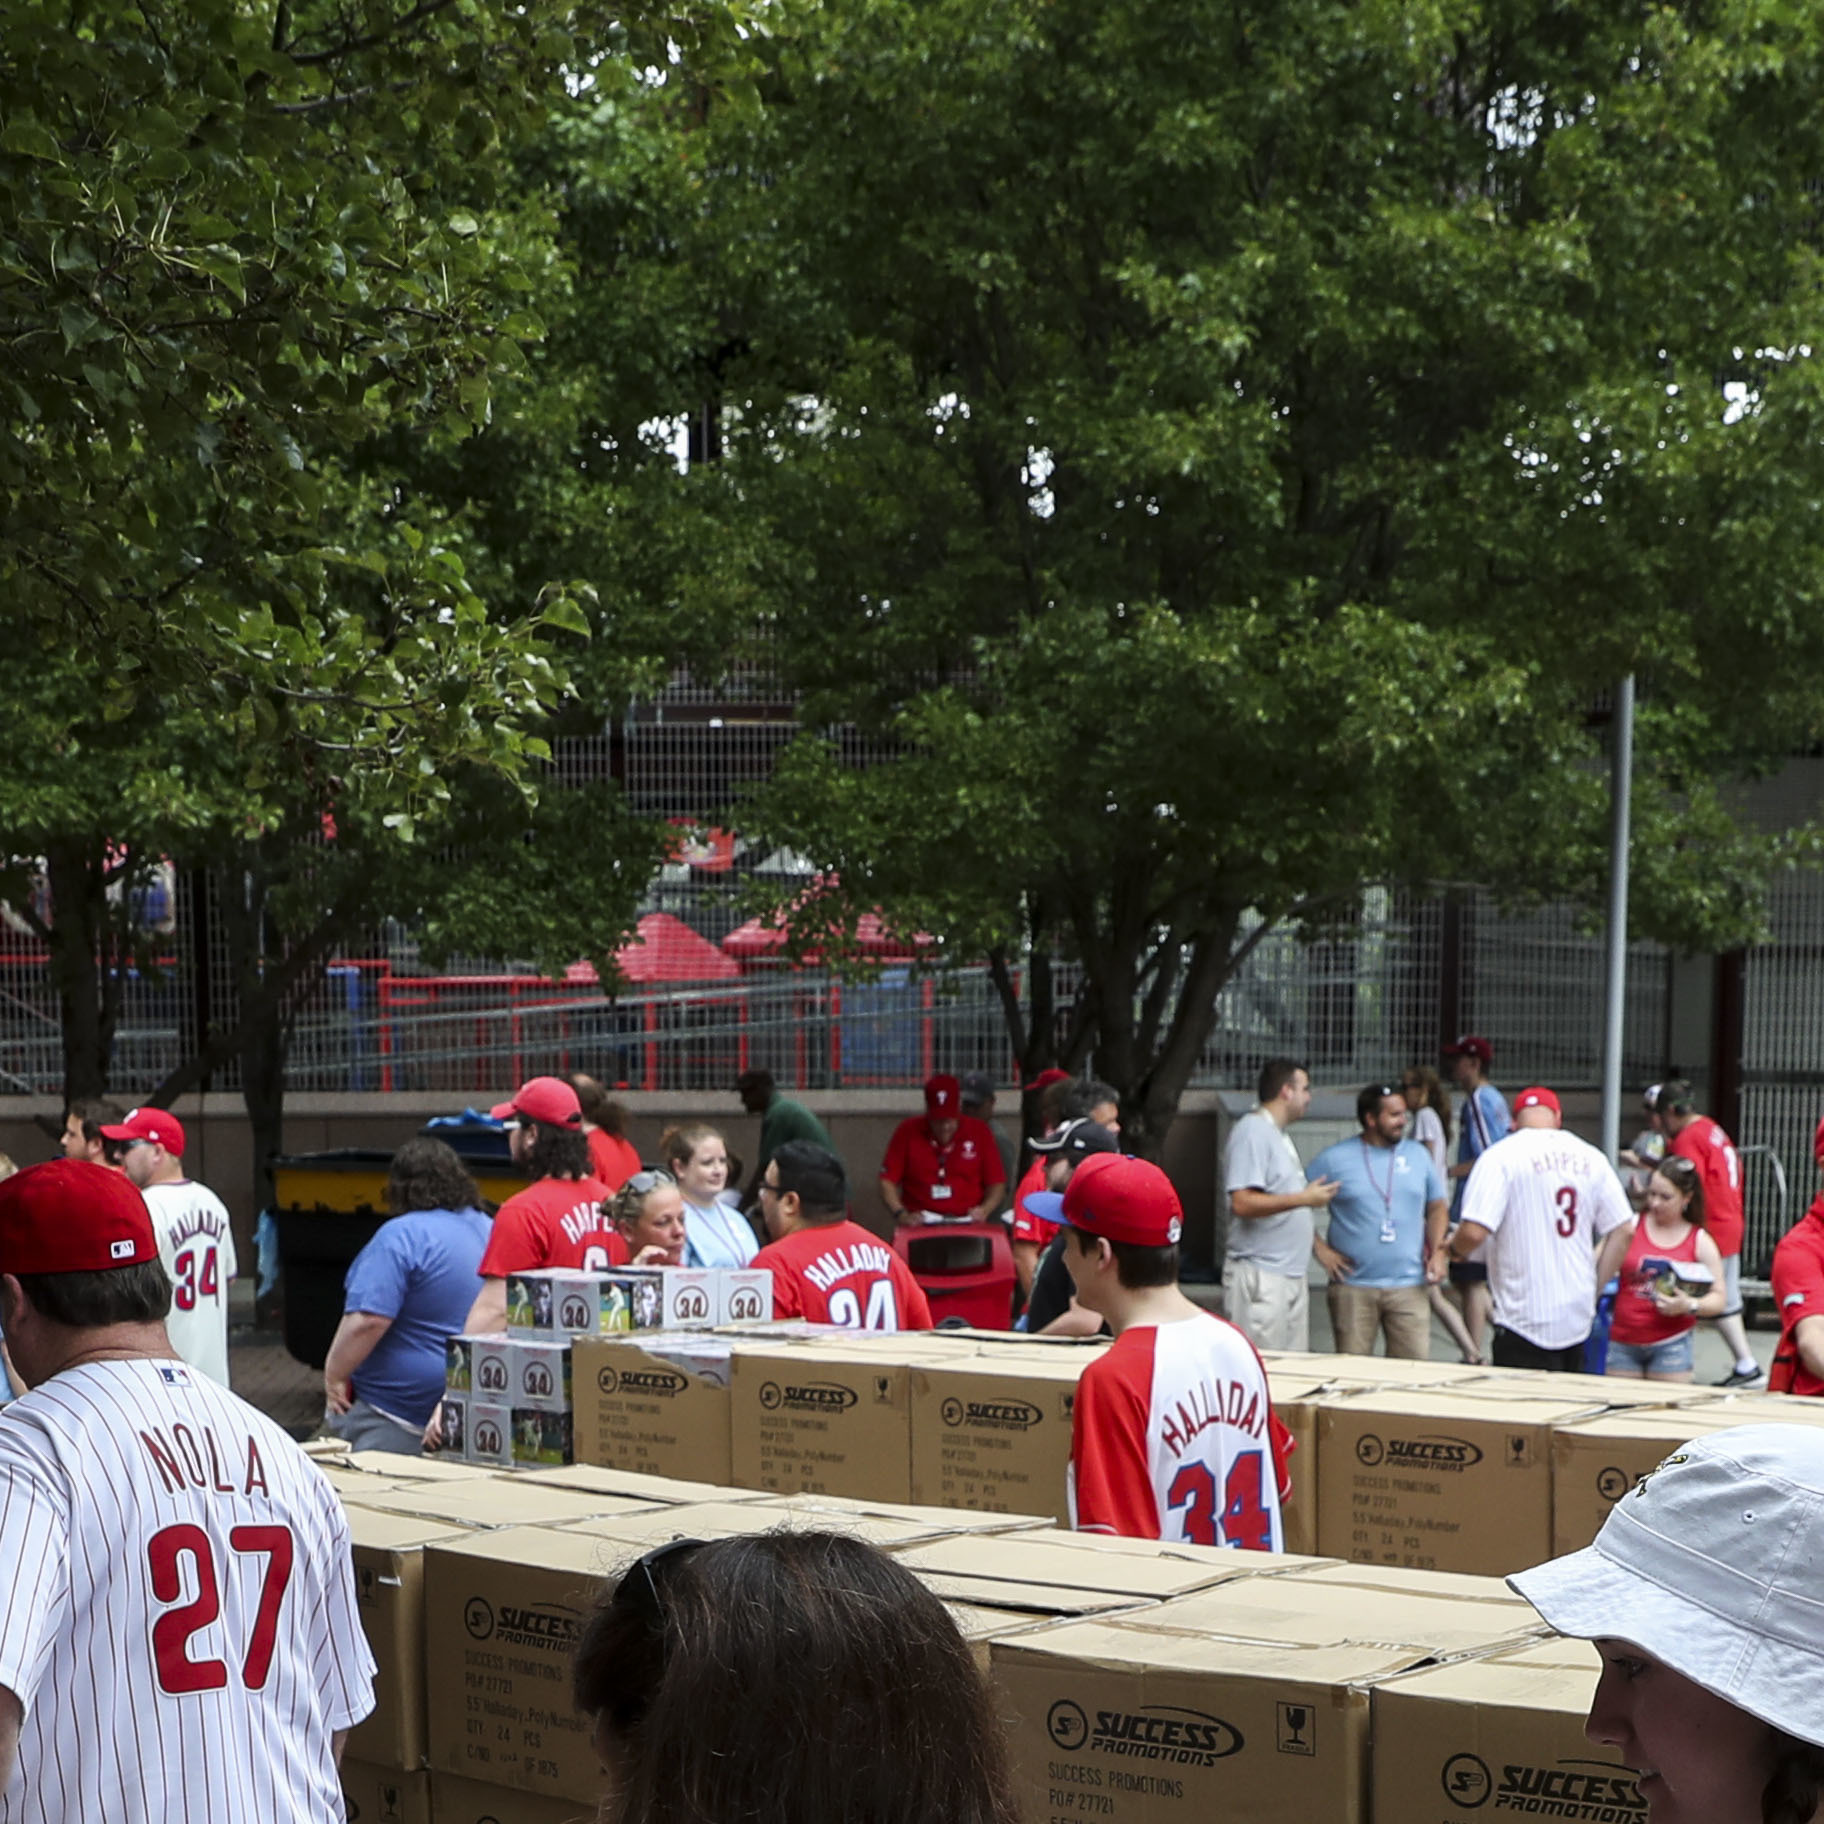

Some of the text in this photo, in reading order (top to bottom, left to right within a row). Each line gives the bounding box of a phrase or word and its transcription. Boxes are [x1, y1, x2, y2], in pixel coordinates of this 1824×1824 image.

[170, 1209, 227, 1254] HALLADAY
[560, 1200, 615, 1245] HARPE
[1555, 1186, 1577, 1239] 3
[176, 1244, 220, 1312] 34
[804, 1243, 892, 1293] HALLADAY
[680, 1296, 703, 1318] 34
[733, 1296, 756, 1318] 34
[828, 1278, 899, 1330] 34
[618, 1371, 676, 1389] SUCCESS
[783, 1385, 846, 1406] SUCCESS
[966, 1402, 1031, 1423] SUCCESS
[137, 1421, 269, 1500] NOLA
[1384, 1455, 1466, 1473] PROMOTIONS
[1387, 1438, 1468, 1462] SUCCESS
[1166, 1450, 1273, 1552] 34
[146, 1522, 295, 1697] 27
[496, 1725, 511, 1743] 24
[1093, 1711, 1220, 1751] SUCCESS
[1090, 1736, 1216, 1768] PROMOTIONS
[1048, 1761, 1184, 1799] SUCCESS PROMOTIONS
[1496, 1764, 1651, 1810] SUCCESS
[1048, 1787, 1115, 1815] PO# 27721
